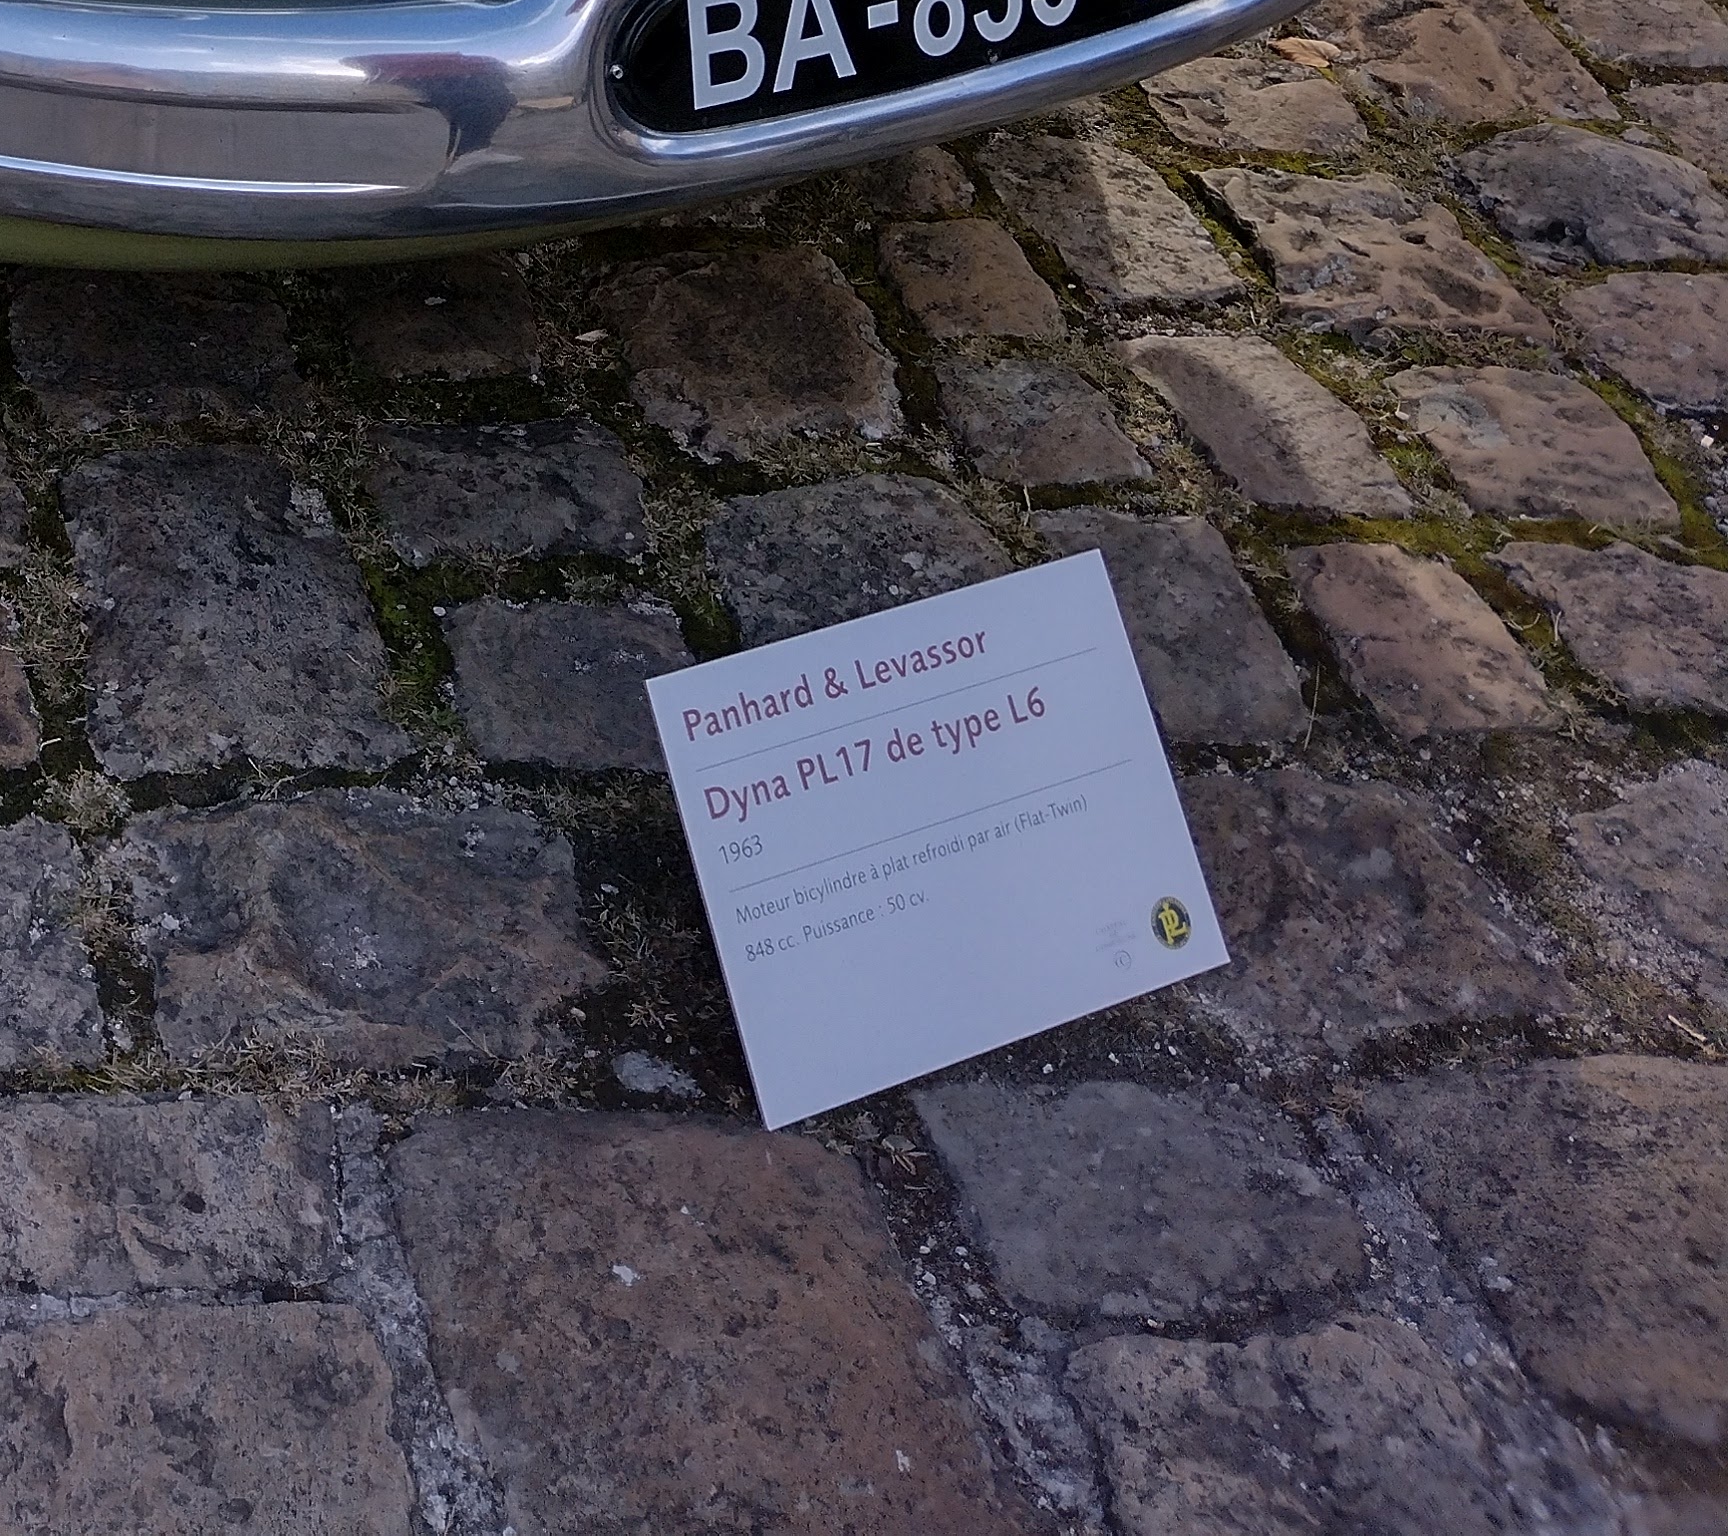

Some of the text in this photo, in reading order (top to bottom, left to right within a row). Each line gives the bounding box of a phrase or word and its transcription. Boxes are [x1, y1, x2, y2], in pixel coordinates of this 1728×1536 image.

[682, 630, 987, 741] Panhard & Levassor
[703, 686, 1046, 822] Dyna PL17 de type L6
[718, 833, 764, 865] 1963
[735, 794, 1089, 924] Moteur bicylindre à plat refroidi par air (Flat-Twin)
[744, 937, 775, 962] 848
[778, 933, 800, 952] cc.
[803, 907, 874, 942] Puissance
[886, 893, 906, 916] 50
[908, 887, 930, 907] cv.
